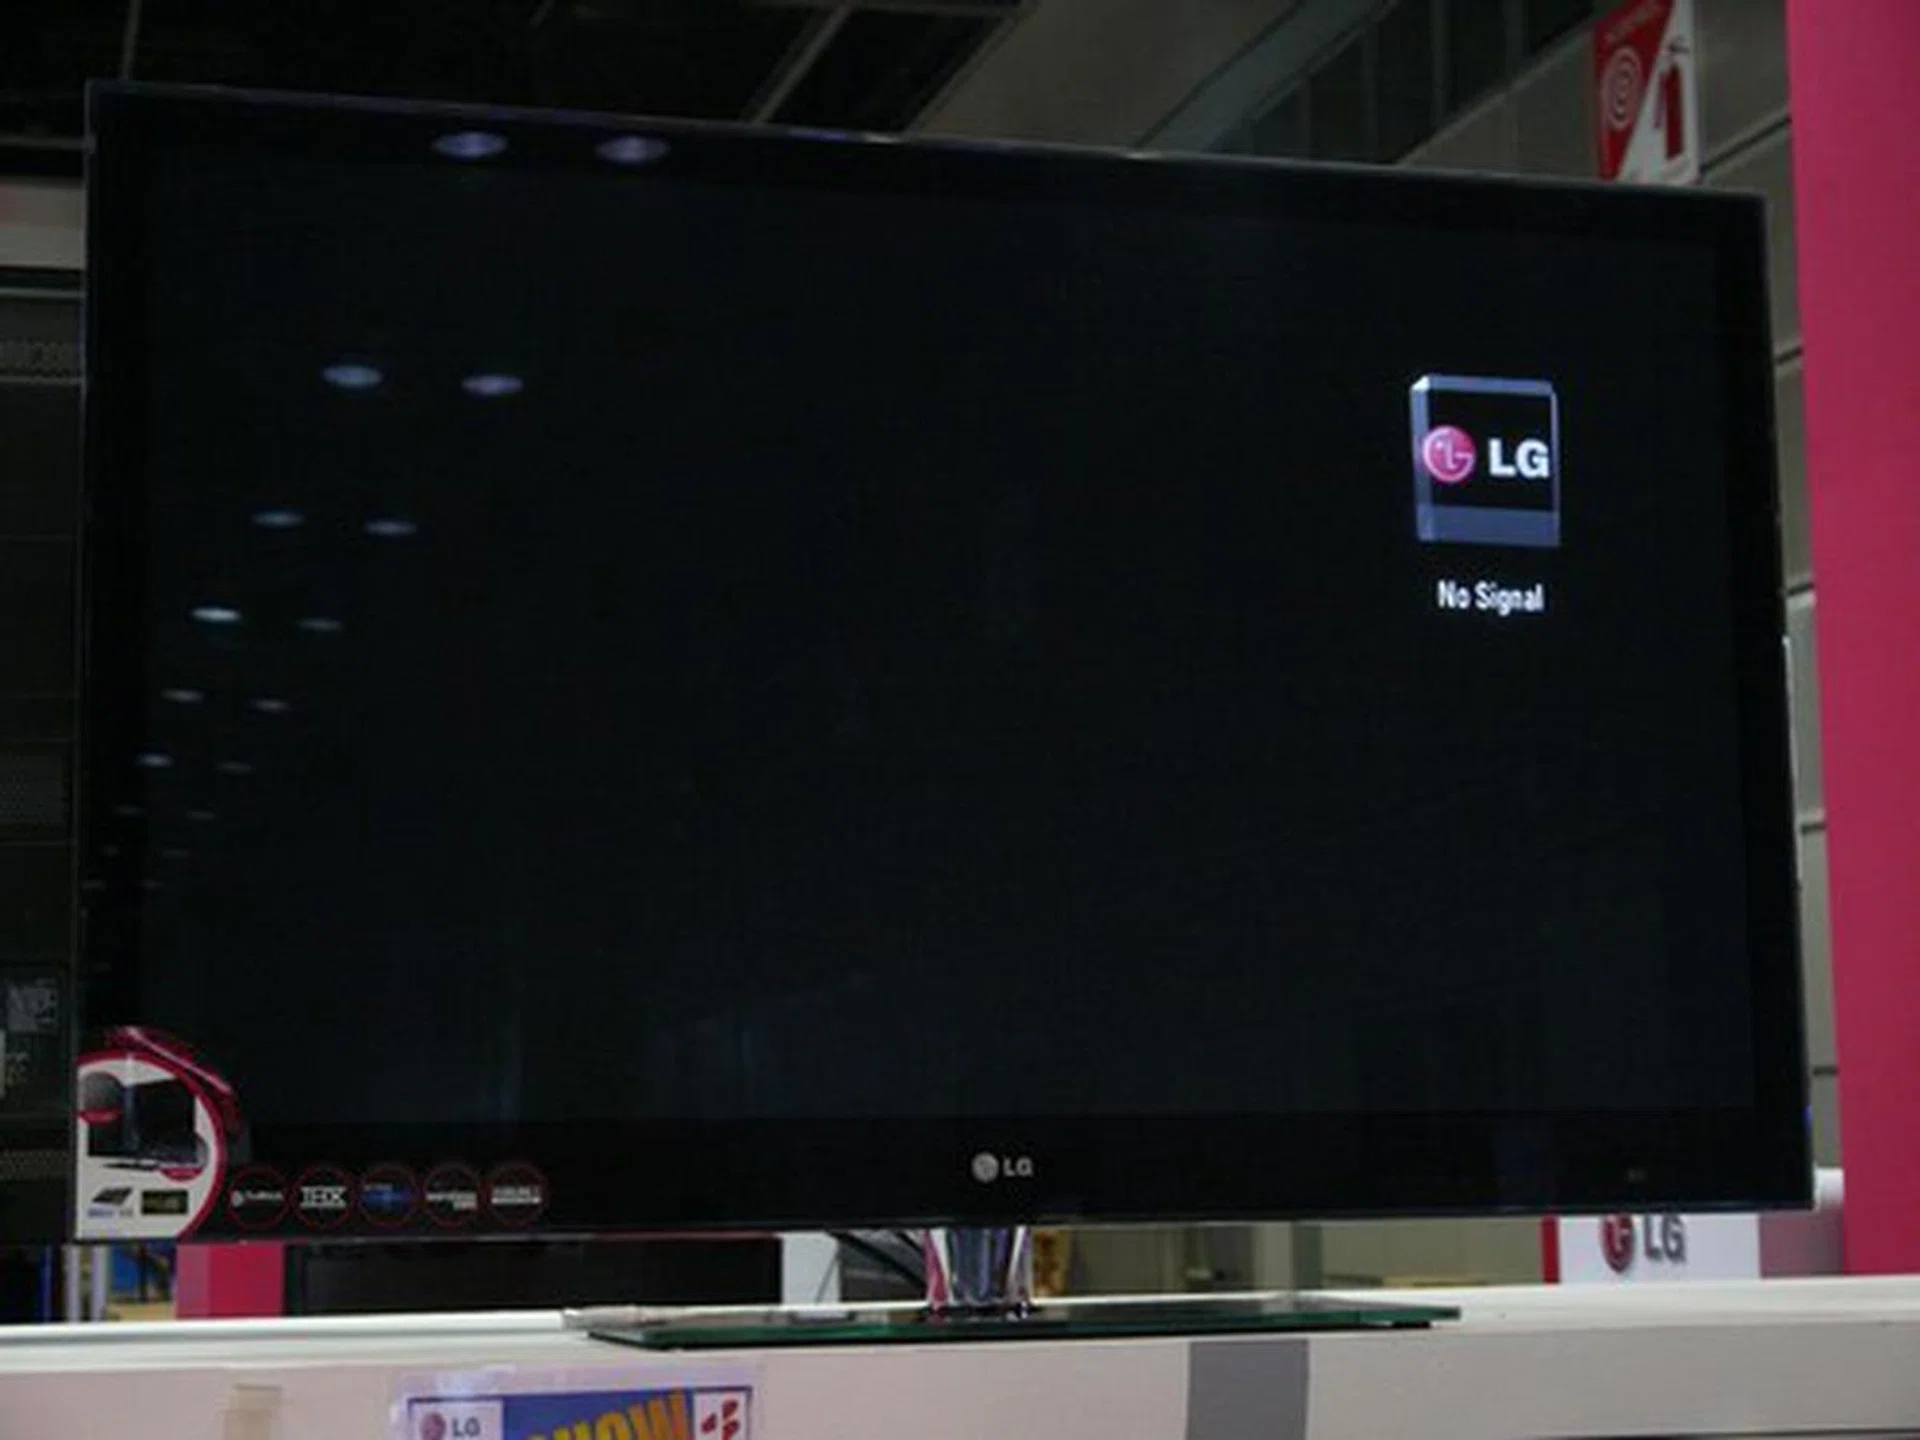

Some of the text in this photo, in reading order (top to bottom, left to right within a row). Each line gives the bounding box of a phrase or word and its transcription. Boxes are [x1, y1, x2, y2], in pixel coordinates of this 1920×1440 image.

[1488, 437, 1550, 478] LG
[1437, 579, 1545, 616] No Signal
[1002, 1154, 1035, 1178] LG
[1645, 1212, 1686, 1263] LG
